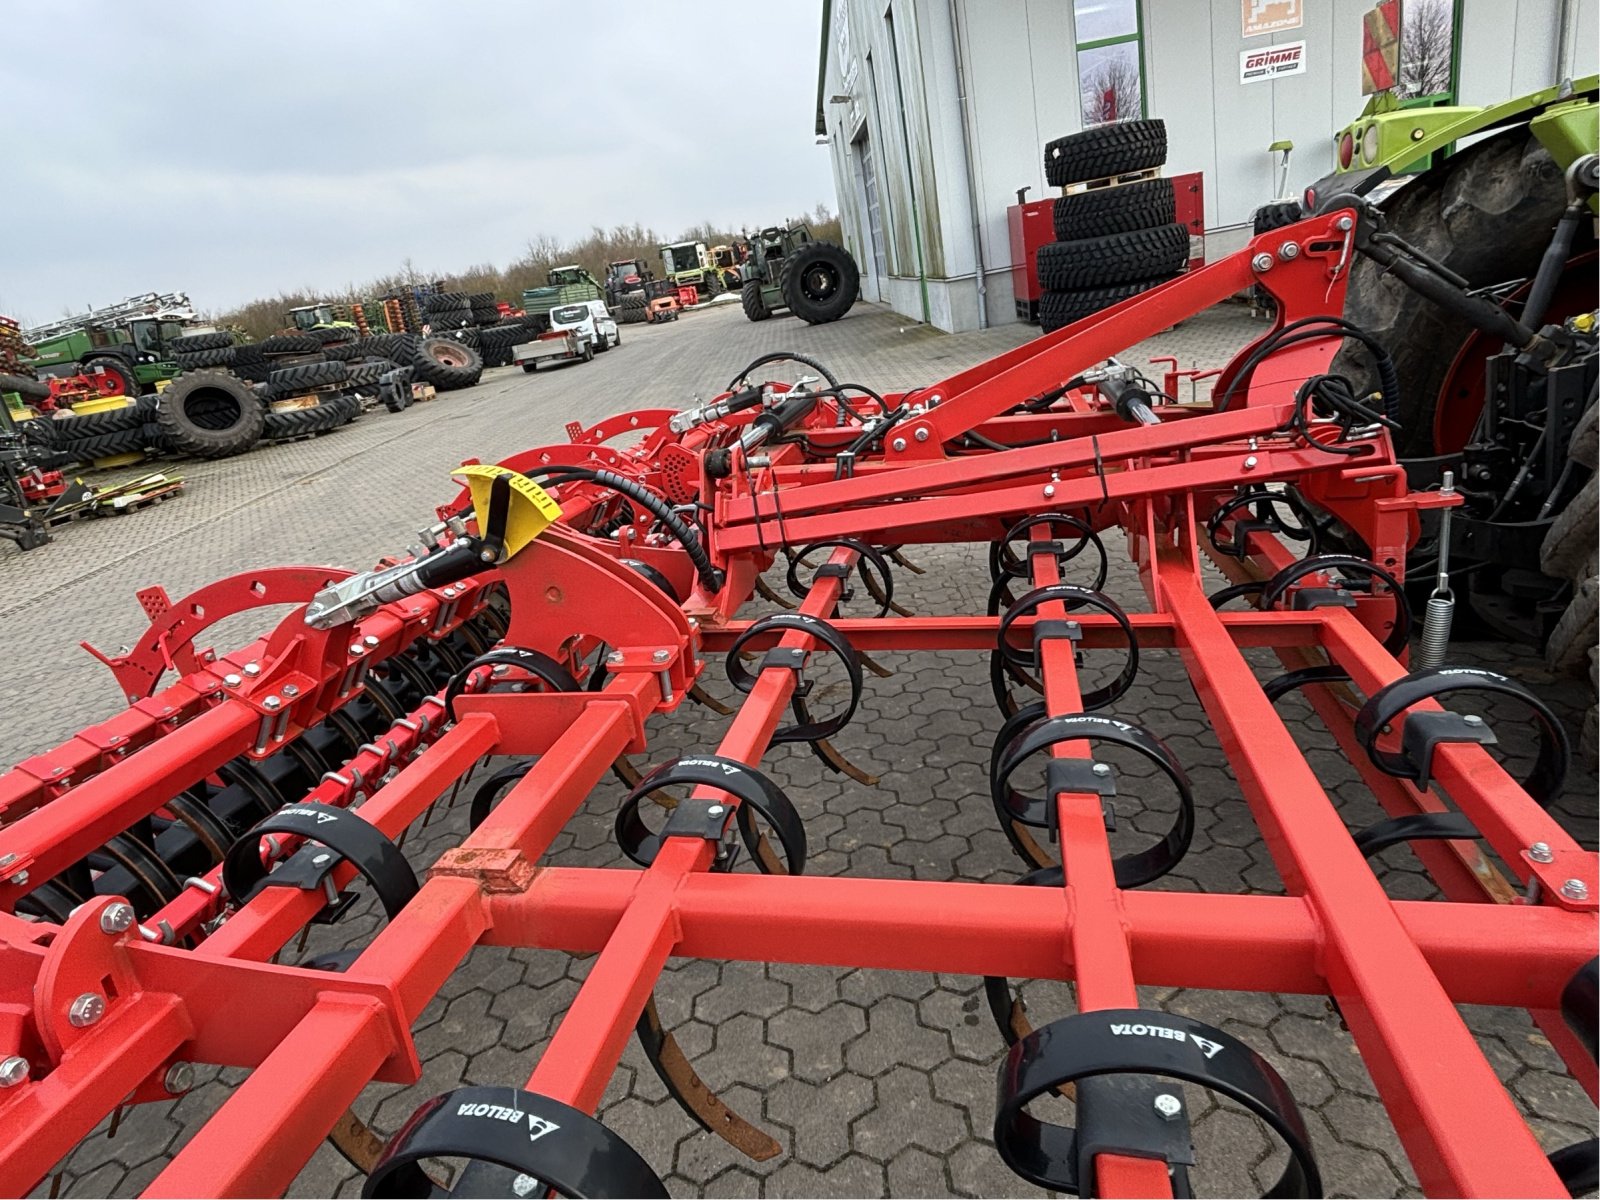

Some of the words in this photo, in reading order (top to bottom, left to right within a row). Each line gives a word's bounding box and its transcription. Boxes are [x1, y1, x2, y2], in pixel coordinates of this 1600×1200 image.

[1245, 16, 1301, 33] AMAZONE
[1245, 50, 1302, 69] GRIMME
[1065, 716, 1110, 724] BELLOTA
[678, 759, 720, 768] BELLOTA
[1110, 1023, 1186, 1042] BELLOTA
[457, 1103, 525, 1124] BELLOTA
